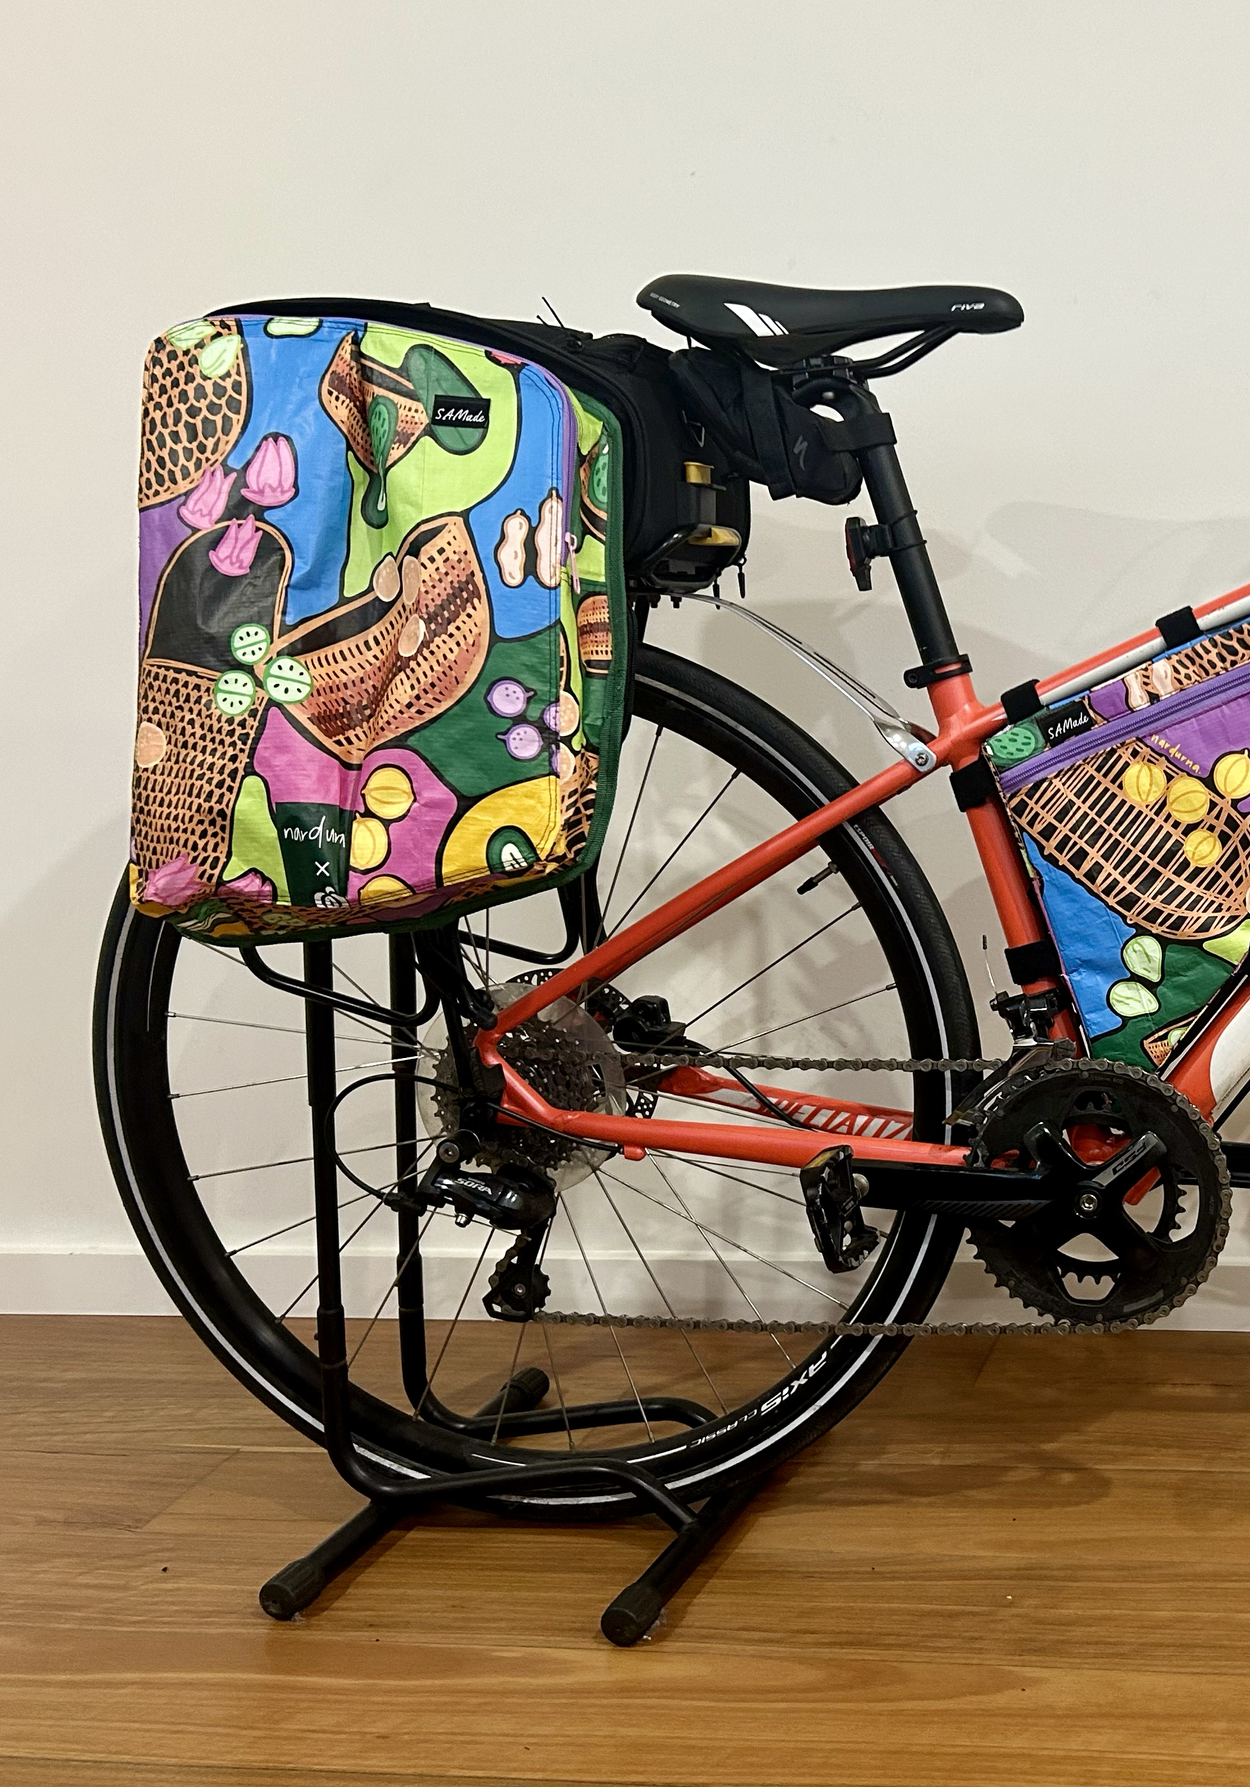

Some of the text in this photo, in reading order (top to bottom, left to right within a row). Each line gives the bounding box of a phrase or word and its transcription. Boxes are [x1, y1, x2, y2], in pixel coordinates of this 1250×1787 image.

[434, 407, 486, 423] SAMade
[1047, 711, 1090, 740] SAMade
[454, 1177, 493, 1197] SORA
[690, 1408, 758, 1449] CLASSIC
